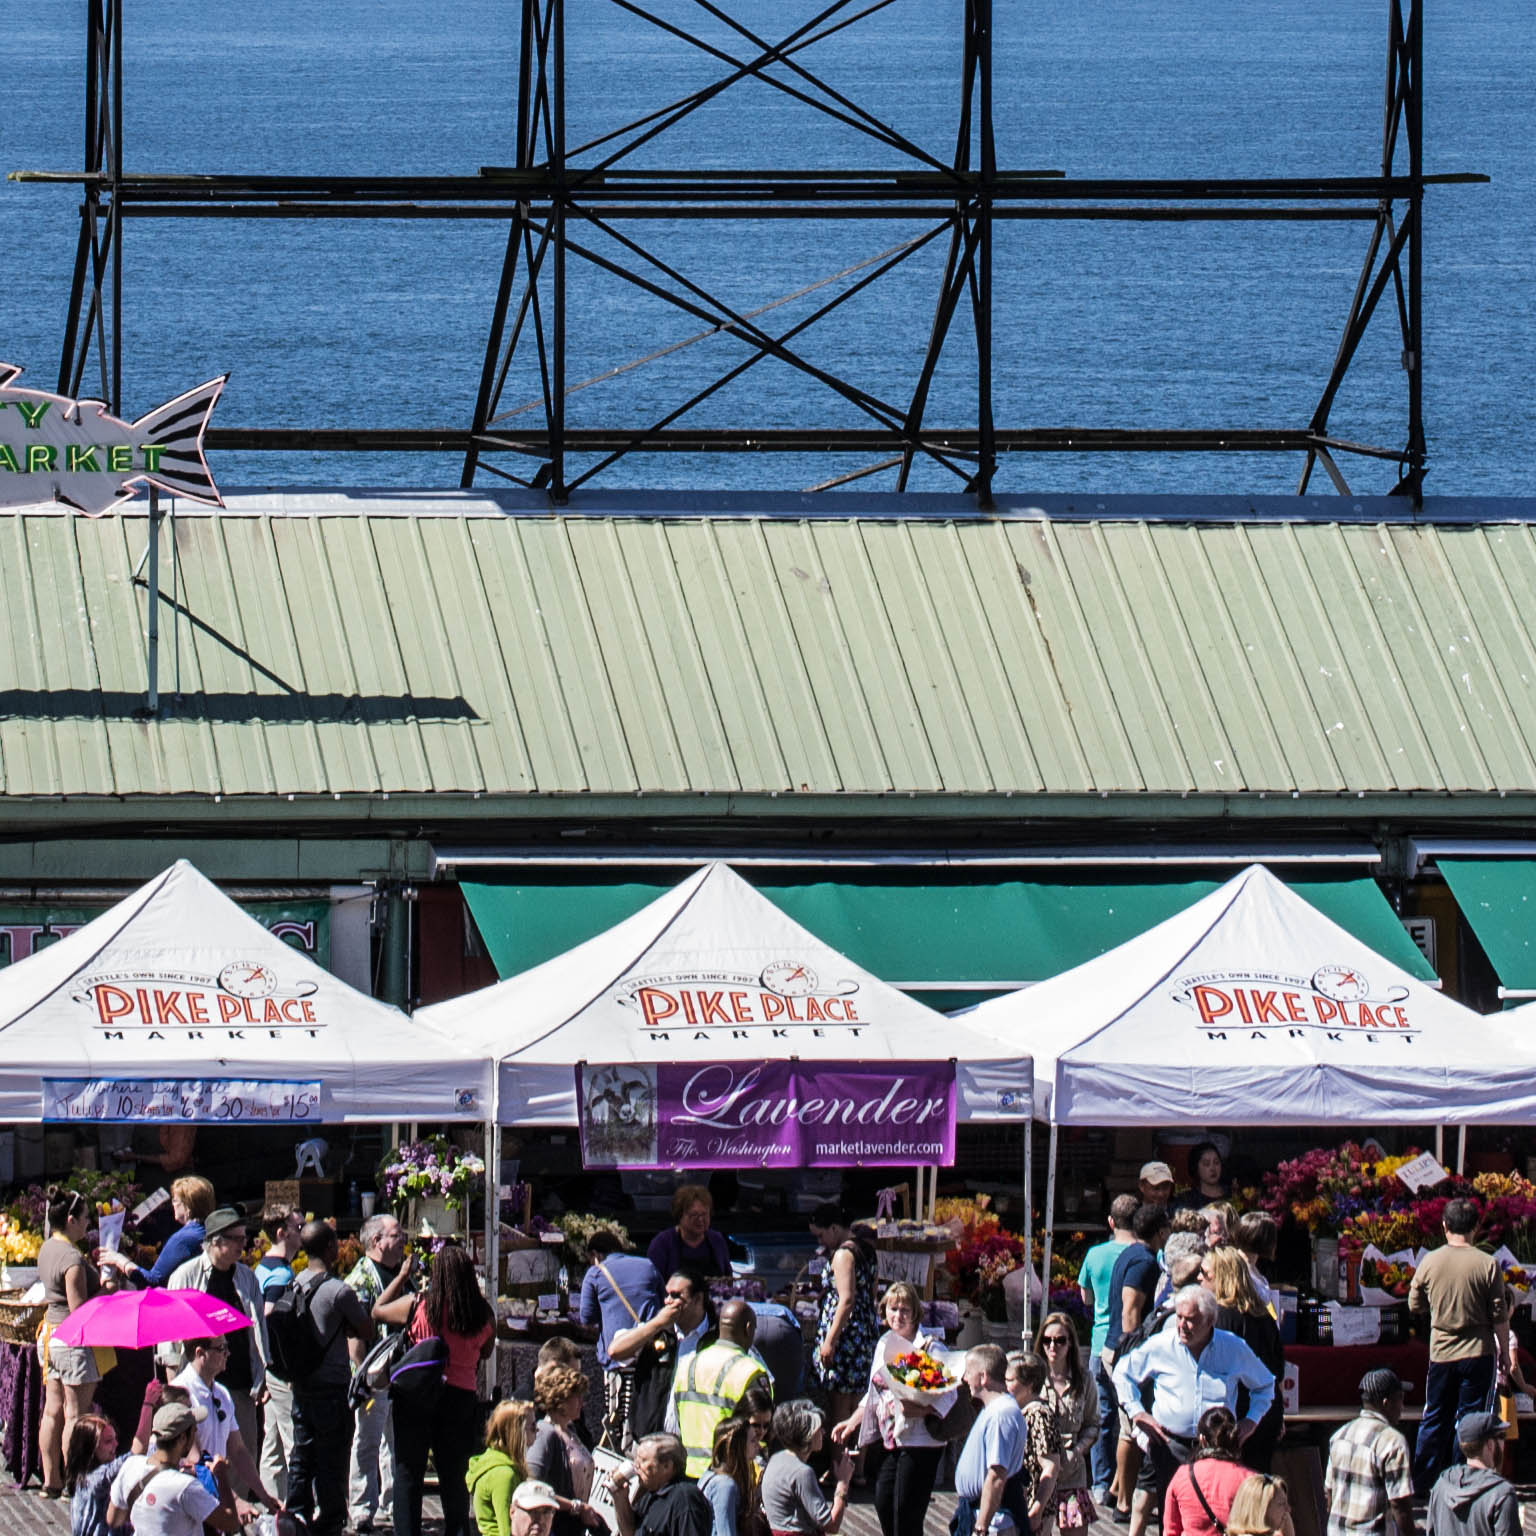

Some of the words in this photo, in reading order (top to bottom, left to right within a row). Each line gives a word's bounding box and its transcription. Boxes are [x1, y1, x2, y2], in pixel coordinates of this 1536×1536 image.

[159, 972, 184, 981] SINCE
[675, 973, 698, 981] OWN
[701, 973, 728, 982] SINCE
[1228, 971, 1251, 979] OWN
[1254, 972, 1280, 981] SINCE
[94, 984, 209, 1025] PIKE
[217, 994, 316, 1023] PLACE
[638, 987, 754, 1025] PIKE
[759, 993, 859, 1022] PLACE
[1192, 984, 1308, 1024] PIKE
[1312, 995, 1410, 1028] PLACE
[104, 1029, 319, 1040] MARKET
[650, 1027, 862, 1041] MARKET
[1207, 1029, 1415, 1044] MARKET
[670, 1064, 945, 1129] Lavender
[116, 1095, 133, 1117] 10
[215, 1096, 243, 1118] 30
[708, 1136, 792, 1162] Washington
[816, 1139, 944, 1156] marketlavender.com
